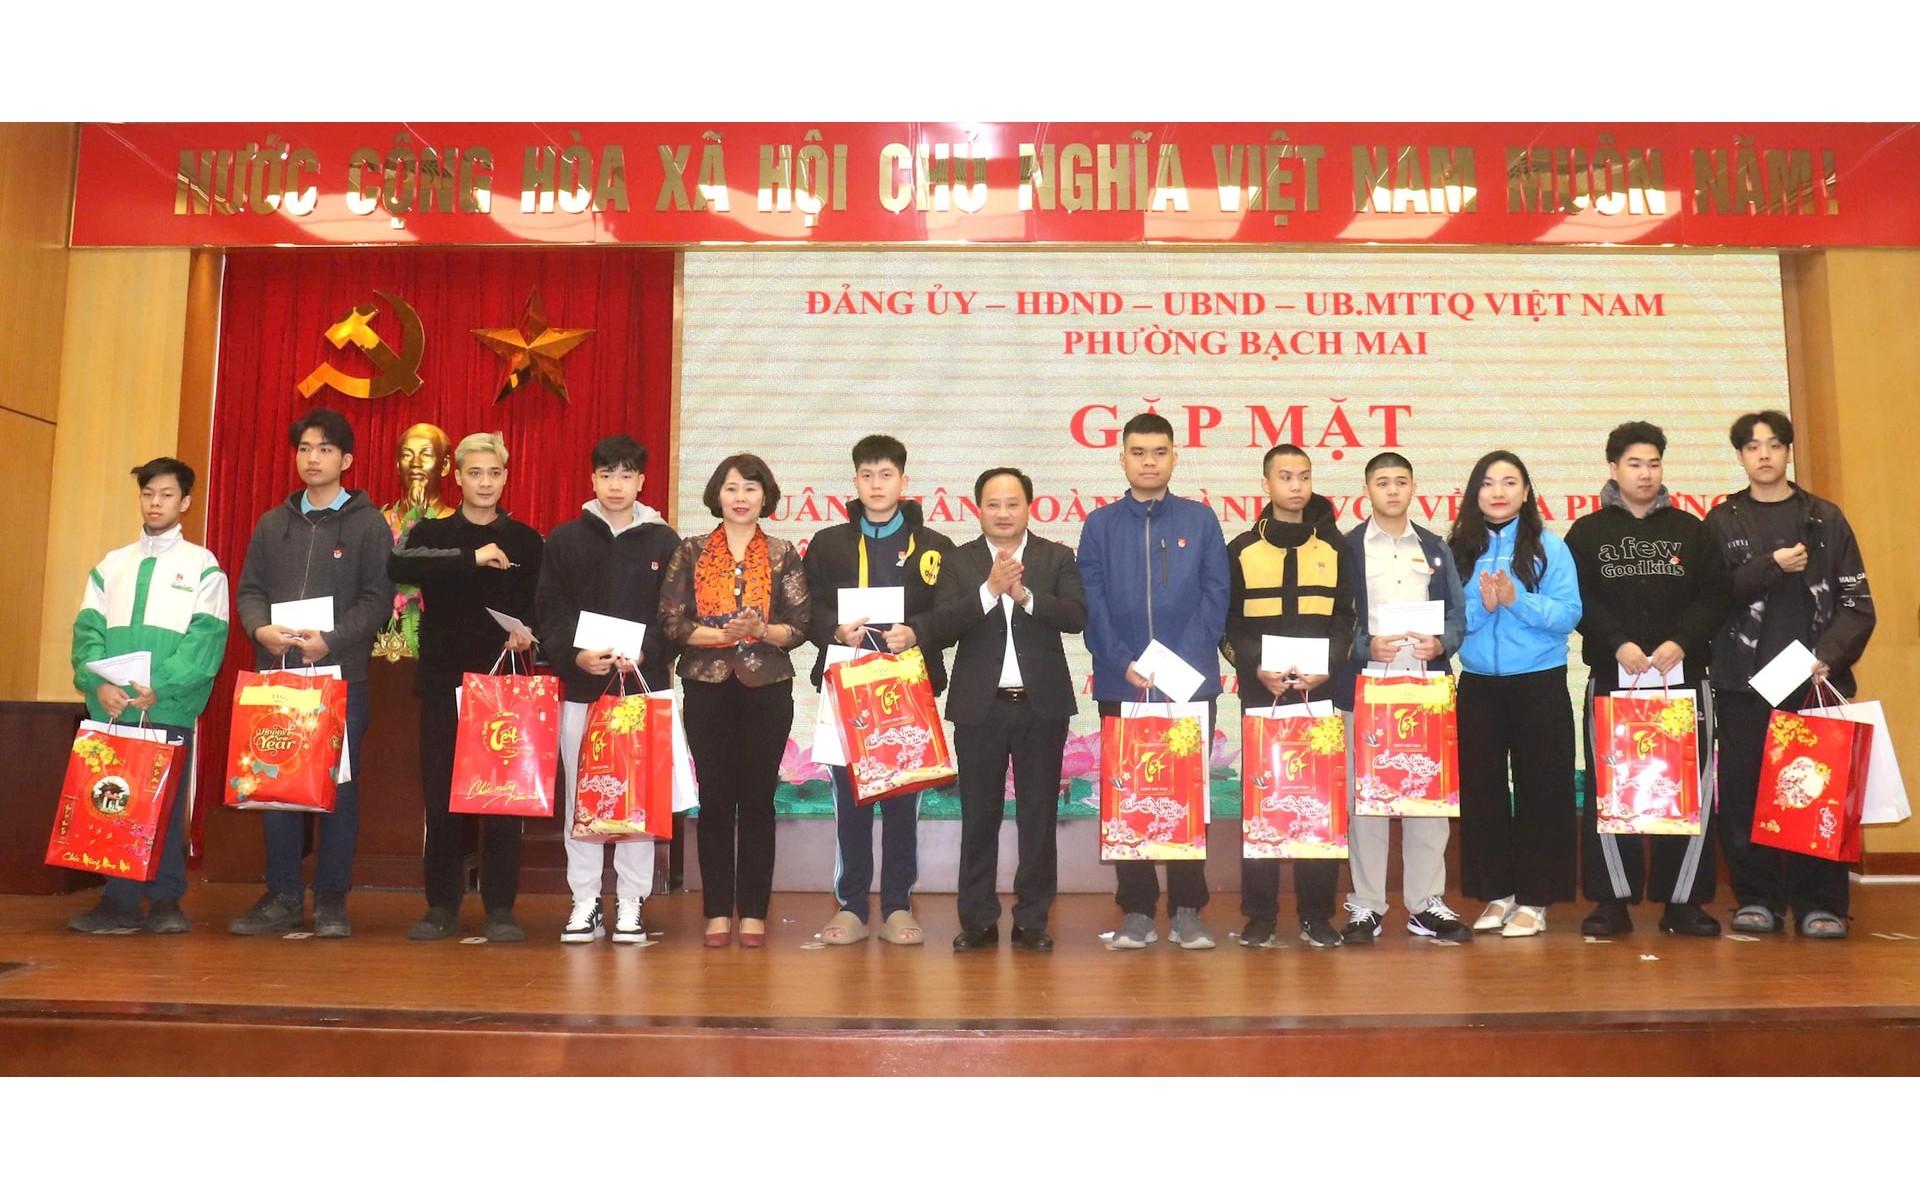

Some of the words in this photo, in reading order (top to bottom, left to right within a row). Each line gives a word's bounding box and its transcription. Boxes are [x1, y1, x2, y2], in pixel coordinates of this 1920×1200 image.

[174, 134, 321, 216] NƯỚC
[346, 132, 495, 229] CỘNG
[520, 130, 628, 214] HÒA
[656, 129, 731, 212] XÃ
[757, 128, 847, 228] HỘI
[879, 129, 988, 214] CHỦ
[1018, 130, 1190, 214] NGHĨA
[1212, 129, 1326, 227] VIỆT
[1353, 145, 1477, 214] NAM
[1506, 132, 1667, 215] MUÔN
[806, 284, 914, 315] ĐẢNG
[926, 284, 978, 315] ỦY
[1017, 291, 1124, 315] HĐND
[1164, 291, 1266, 315] UBND
[1306, 291, 1475, 321] UB.MTTQ
[1483, 291, 1571, 322] VIỆT
[1581, 293, 1666, 316] NAM
[1064, 325, 1228, 356] PHƯỜNG
[1240, 331, 1343, 362] BẠCH
[1355, 331, 1428, 356] MAI
[1070, 397, 1222, 449] GP
[1245, 397, 1412, 461] MẶT
[1598, 542, 1619, 562] a
[1620, 536, 1682, 560] few
[256, 735, 297, 751] Year
